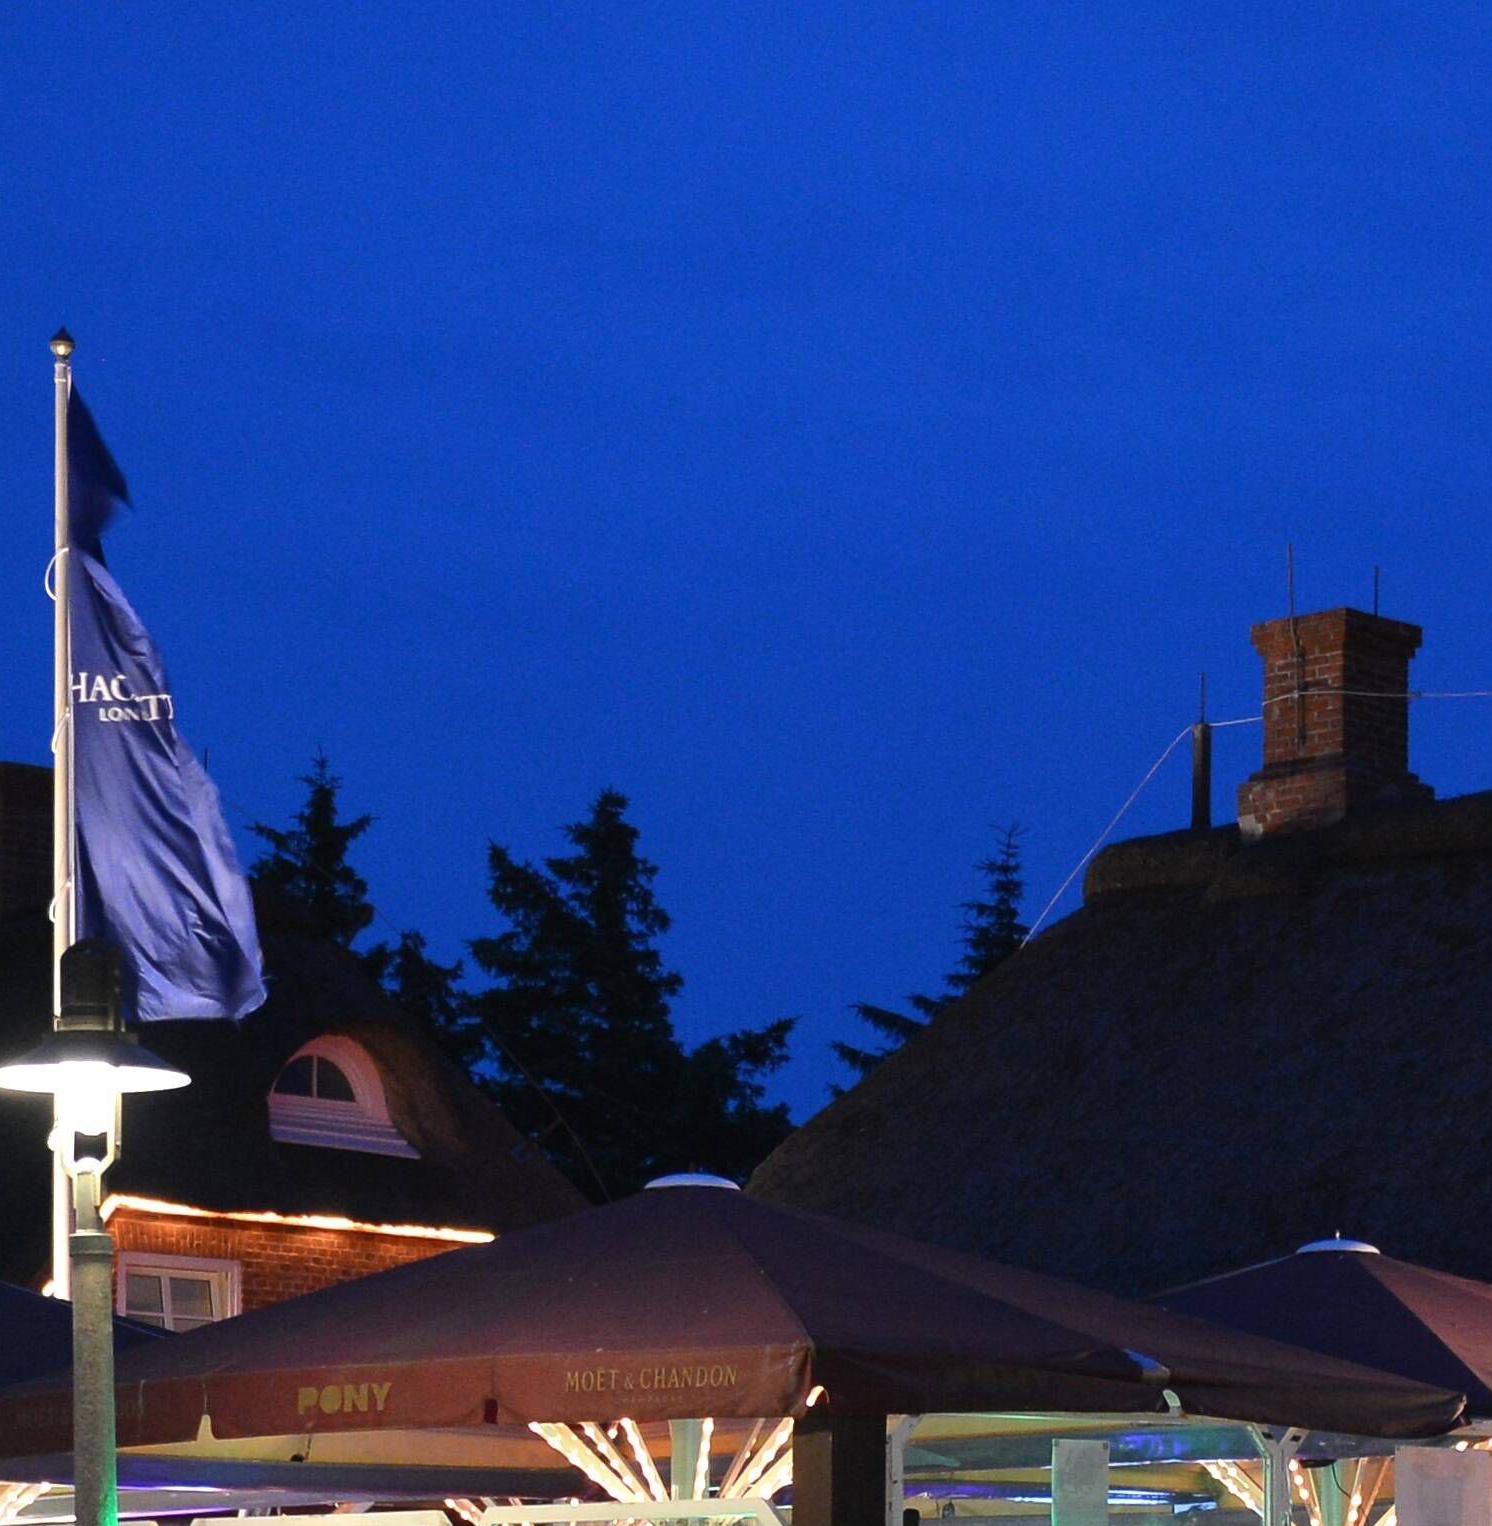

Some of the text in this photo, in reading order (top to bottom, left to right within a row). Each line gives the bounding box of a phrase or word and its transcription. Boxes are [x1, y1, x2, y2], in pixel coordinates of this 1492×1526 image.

[623, 1373, 635, 1391] &
[638, 1365, 738, 1390] CHANDON
[298, 1382, 393, 1415] PONY
